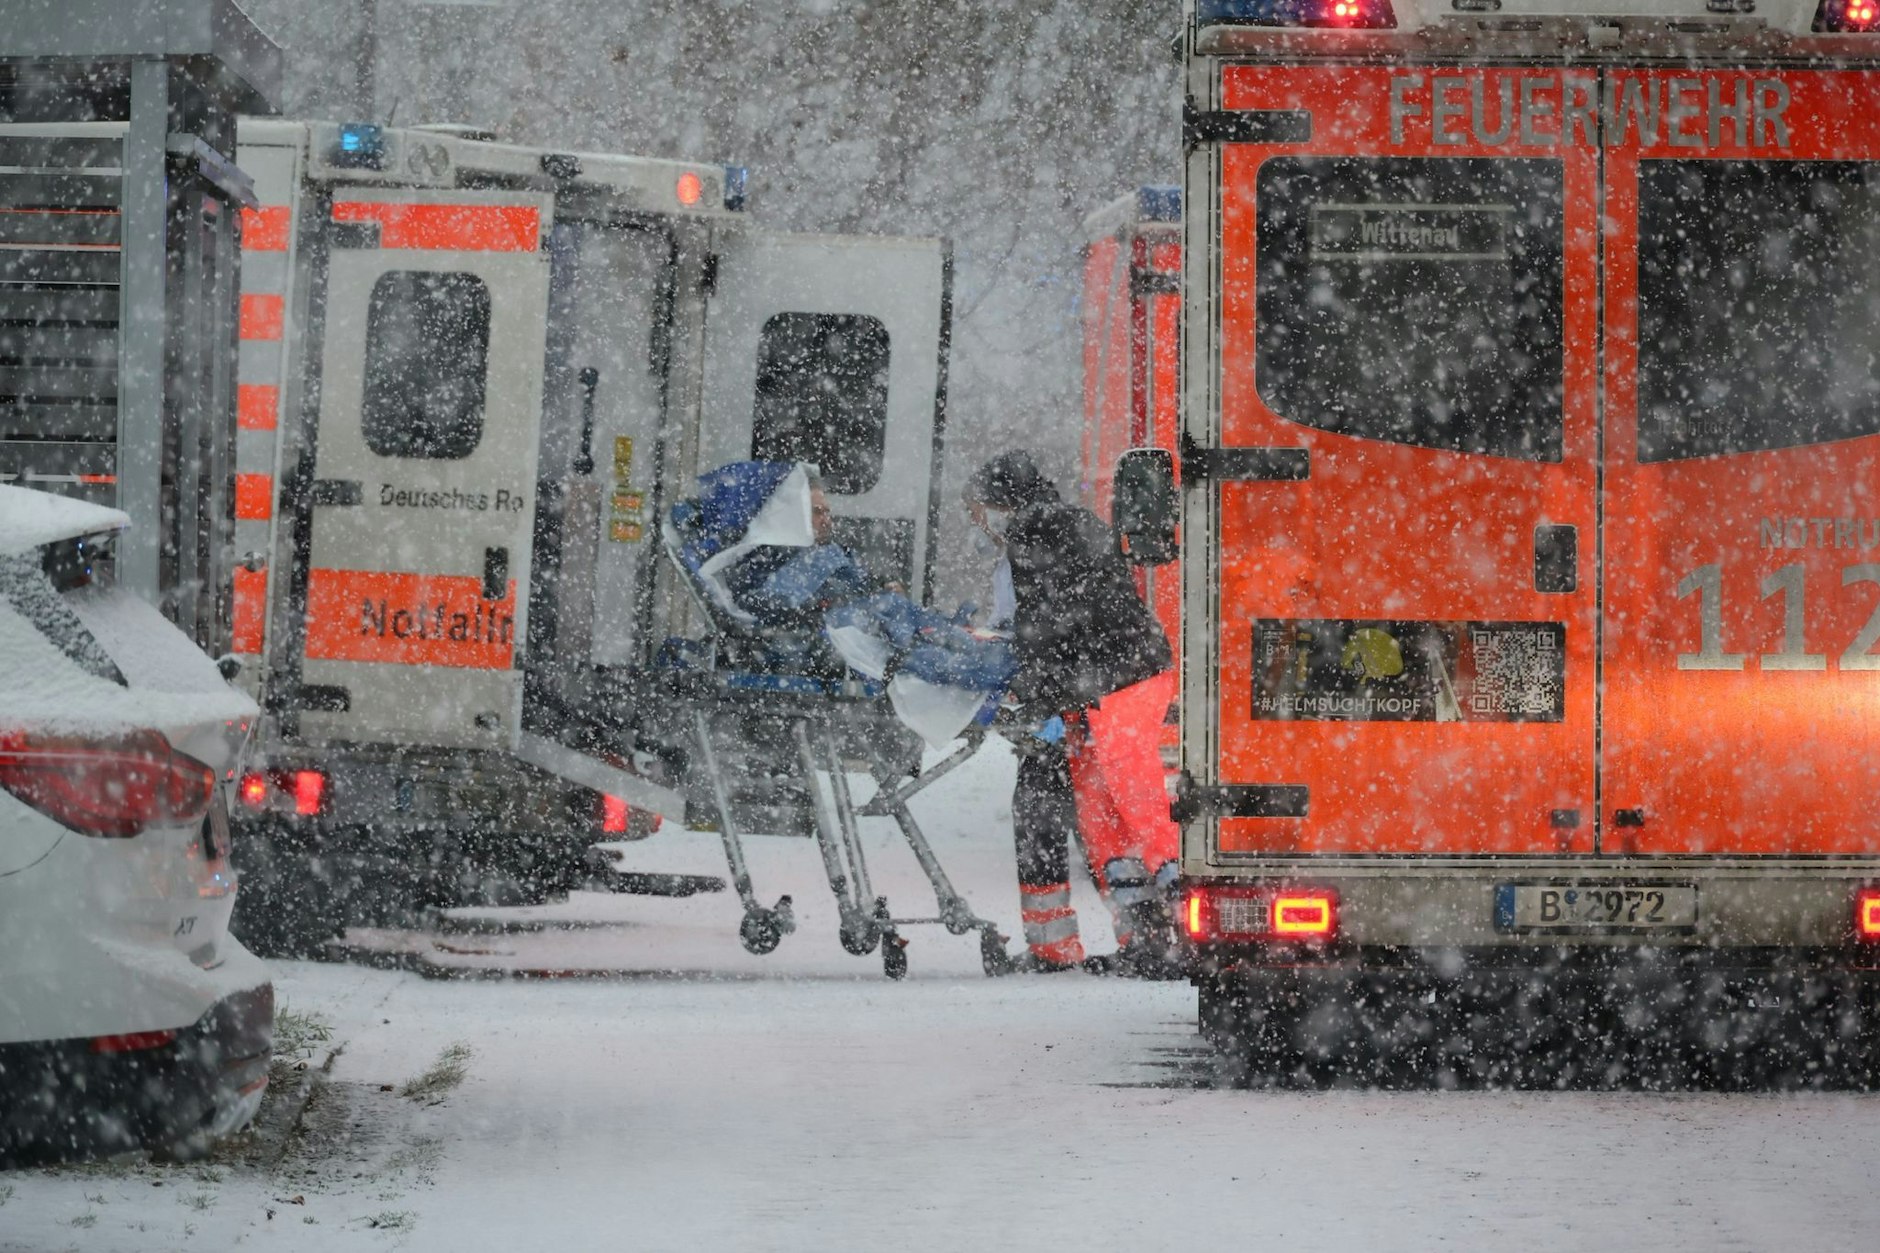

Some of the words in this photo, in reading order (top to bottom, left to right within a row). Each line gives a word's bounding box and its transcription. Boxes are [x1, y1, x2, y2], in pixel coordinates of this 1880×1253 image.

[1389, 76, 1791, 148] FEUERWEHR
[1361, 221, 1460, 249] Wittenau
[380, 483, 489, 511] Deutsches
[496, 488, 525, 512] Ro
[1760, 517, 1880, 549] NOTRU
[1677, 562, 1880, 671] 112
[1260, 697, 1421, 713] #HELMSUCHTKOPF
[1540, 890, 1561, 922] B
[1583, 890, 1665, 923] 2972
